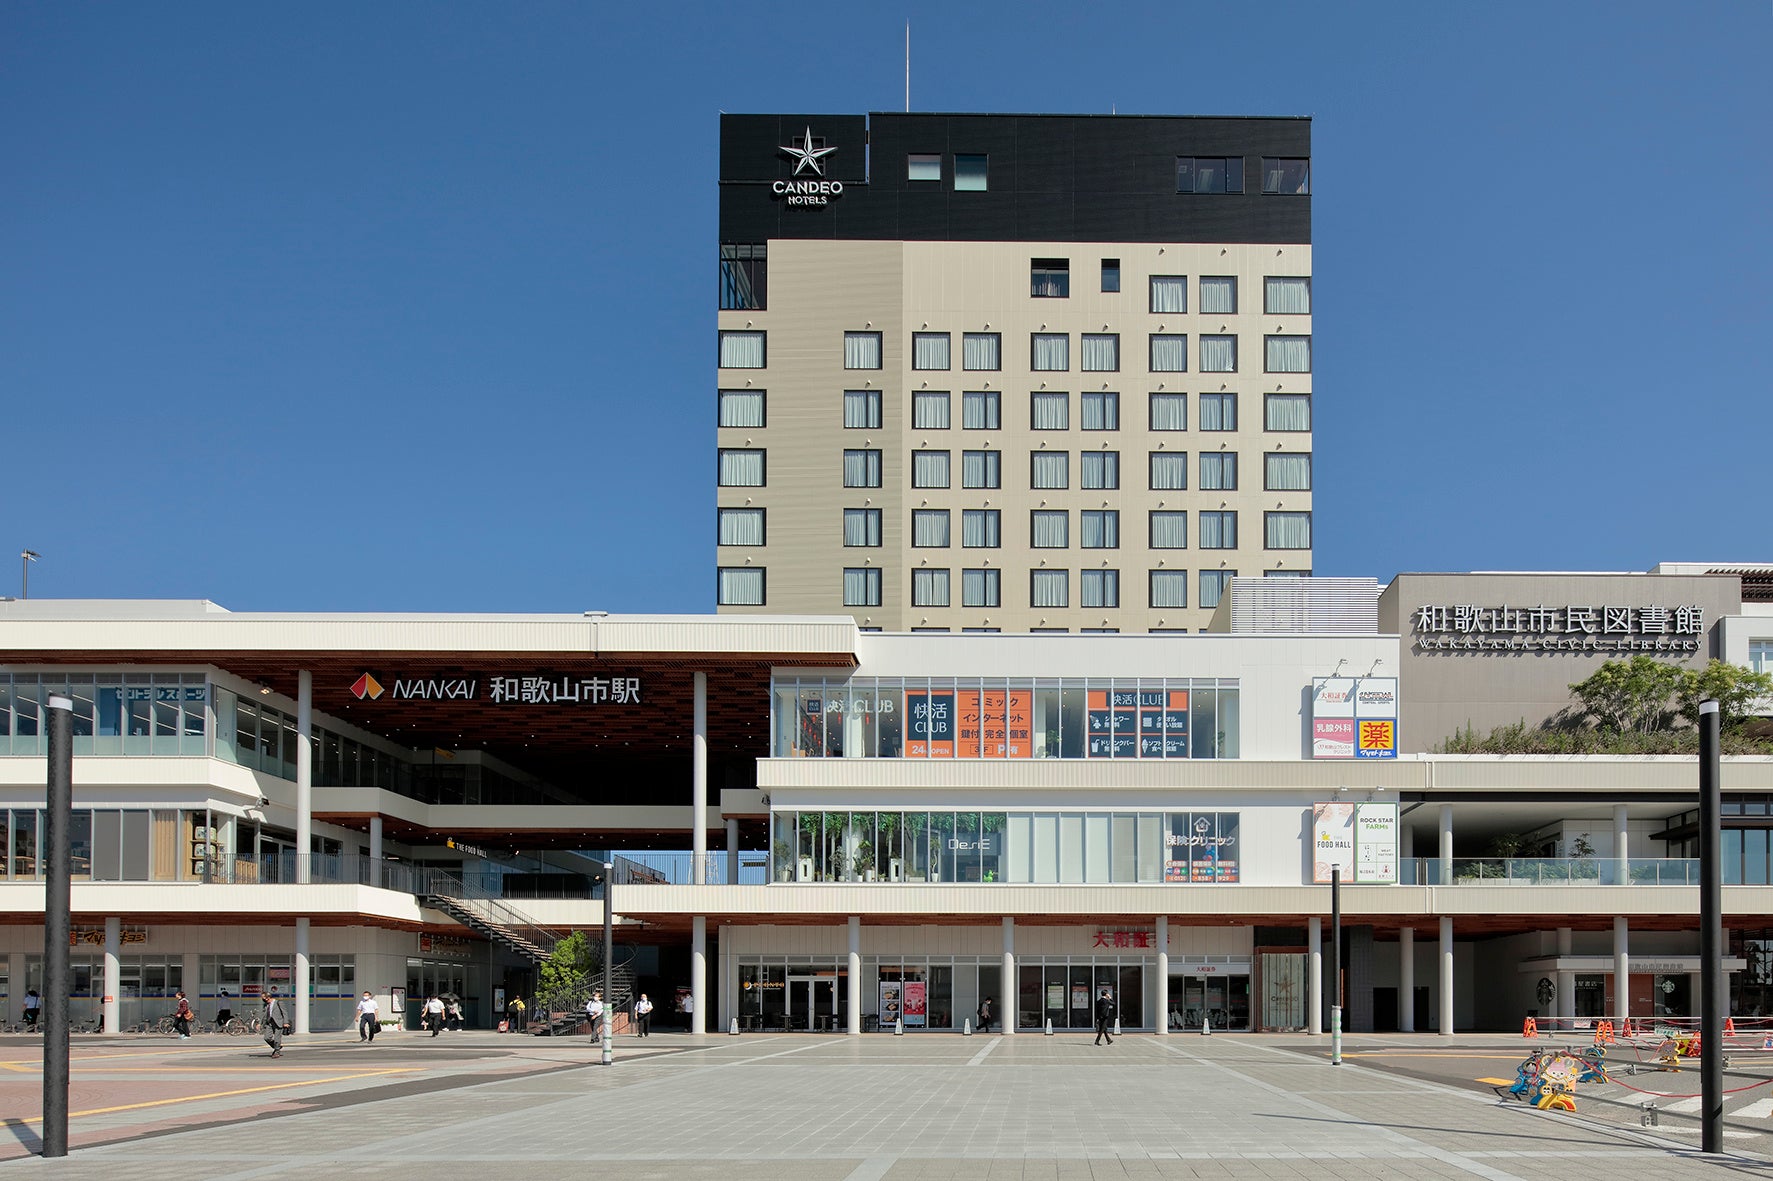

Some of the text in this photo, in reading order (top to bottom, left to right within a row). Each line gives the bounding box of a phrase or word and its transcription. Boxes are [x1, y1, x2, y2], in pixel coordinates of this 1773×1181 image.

[773, 181, 843, 194] CANDEO
[788, 196, 827, 205] HOTELS
[1417, 604, 1704, 634] 和歌山市民図書館
[1419, 640, 1703, 649] WAKAYAMA CIVIC LIBRARY
[392, 677, 640, 703] NANKAI 和歌山市駅
[972, 697, 1018, 707] コミック
[914, 703, 947, 719] 快活
[963, 713, 1023, 723] インターネット
[915, 721, 947, 733] CLUB
[1363, 722, 1389, 748] 薬
[1166, 835, 1236, 847] 保険クリニック
